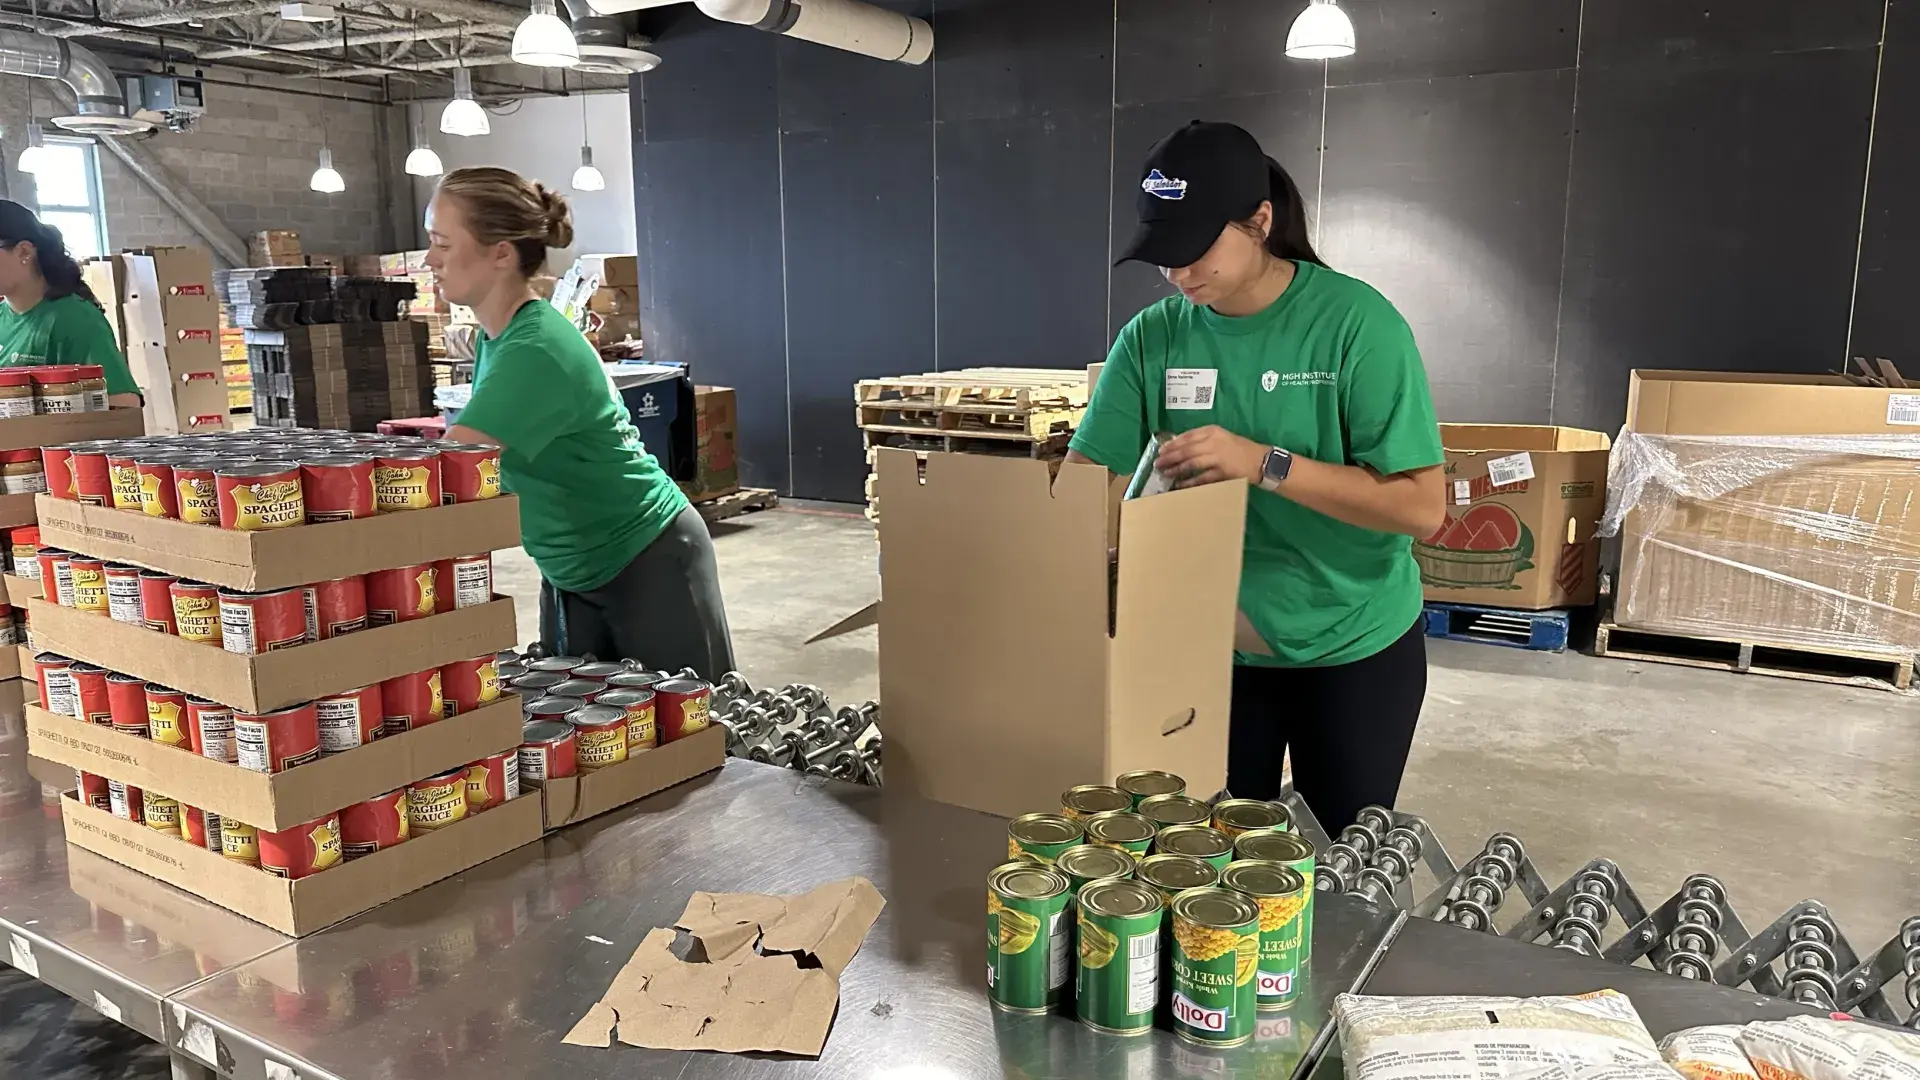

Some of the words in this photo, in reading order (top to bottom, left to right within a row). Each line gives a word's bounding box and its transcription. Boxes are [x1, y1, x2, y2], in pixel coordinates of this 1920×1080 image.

[1282, 373, 1301, 381] MGH
[1302, 371, 1336, 380] INSTITUTE
[255, 486, 278, 502] Chef
[261, 511, 300, 525] SAUCE
[581, 753, 615, 762] SAUCE
[414, 810, 452, 822] SAUCE
[72, 818, 101, 835] SPAGHETTI
[1263, 936, 1299, 951] SWEET
[1194, 971, 1233, 986] SWEET
[1194, 985, 1219, 995] Whole
[1173, 994, 1223, 1029] Dolly
[1373, 1050, 1399, 1060] DIRECTIONS
